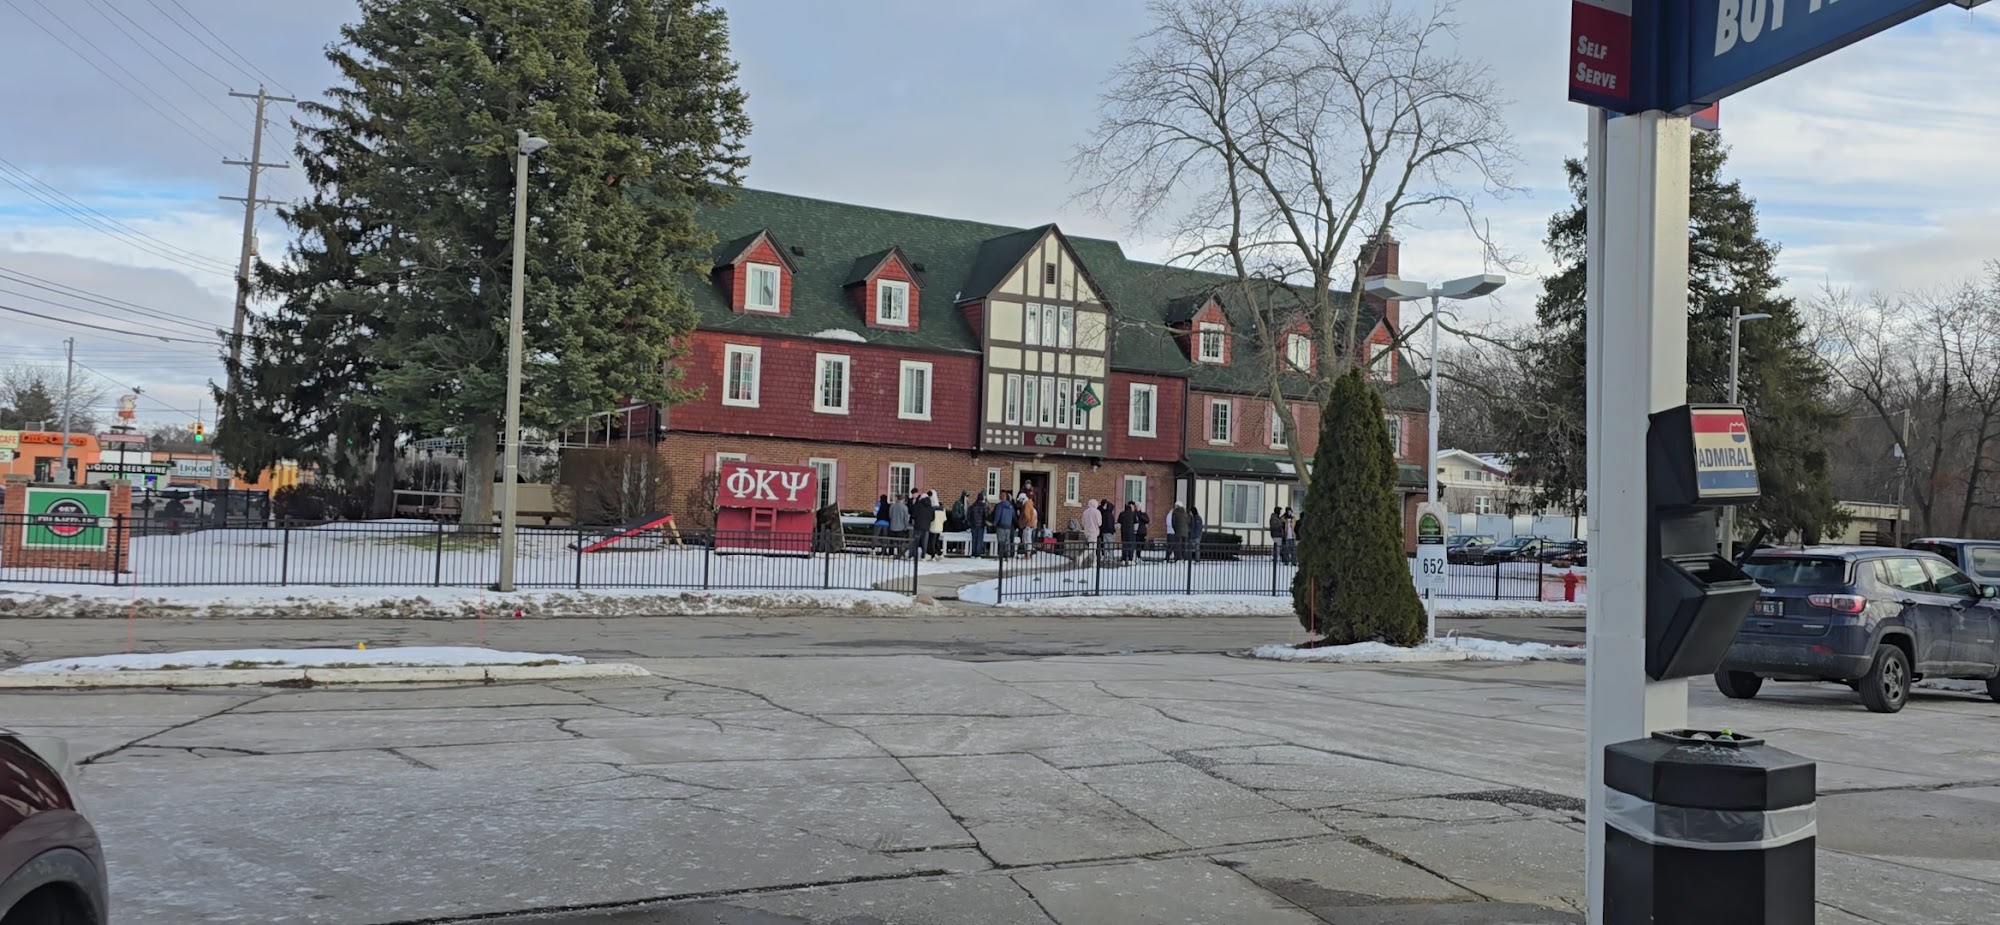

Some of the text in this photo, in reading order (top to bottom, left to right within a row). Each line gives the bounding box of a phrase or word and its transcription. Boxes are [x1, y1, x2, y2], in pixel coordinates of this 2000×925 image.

[1577, 35, 1608, 60] SELF
[1575, 62, 1617, 89] SERVE
[1698, 447, 1752, 468] ADMIRAL
[86, 464, 120, 472] LIQUOR
[216, 468, 229, 477] 35
[1423, 558, 1444, 574] 652
